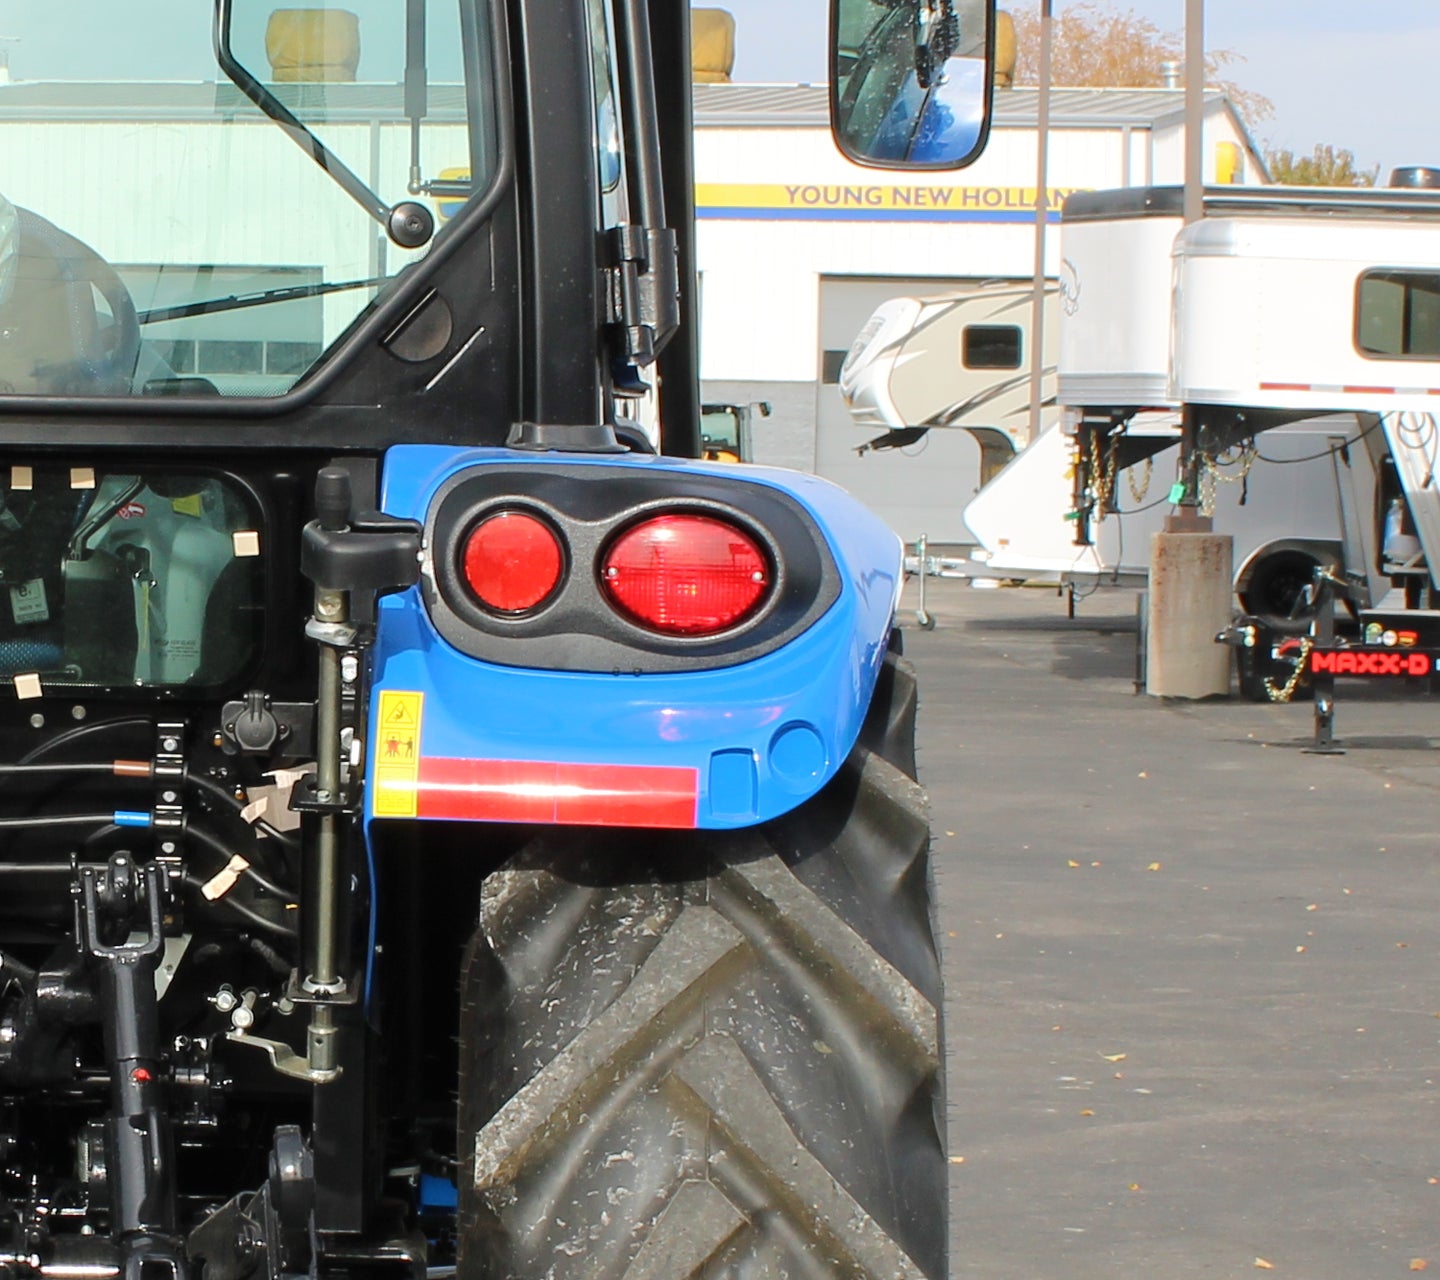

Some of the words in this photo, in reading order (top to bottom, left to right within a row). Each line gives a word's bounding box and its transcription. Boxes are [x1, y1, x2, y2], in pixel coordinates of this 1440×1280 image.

[785, 185, 883, 206] YOUNG
[891, 187, 953, 207] NEW
[961, 187, 1076, 209] HOLLAN
[1311, 651, 1431, 676] MAXX-D
